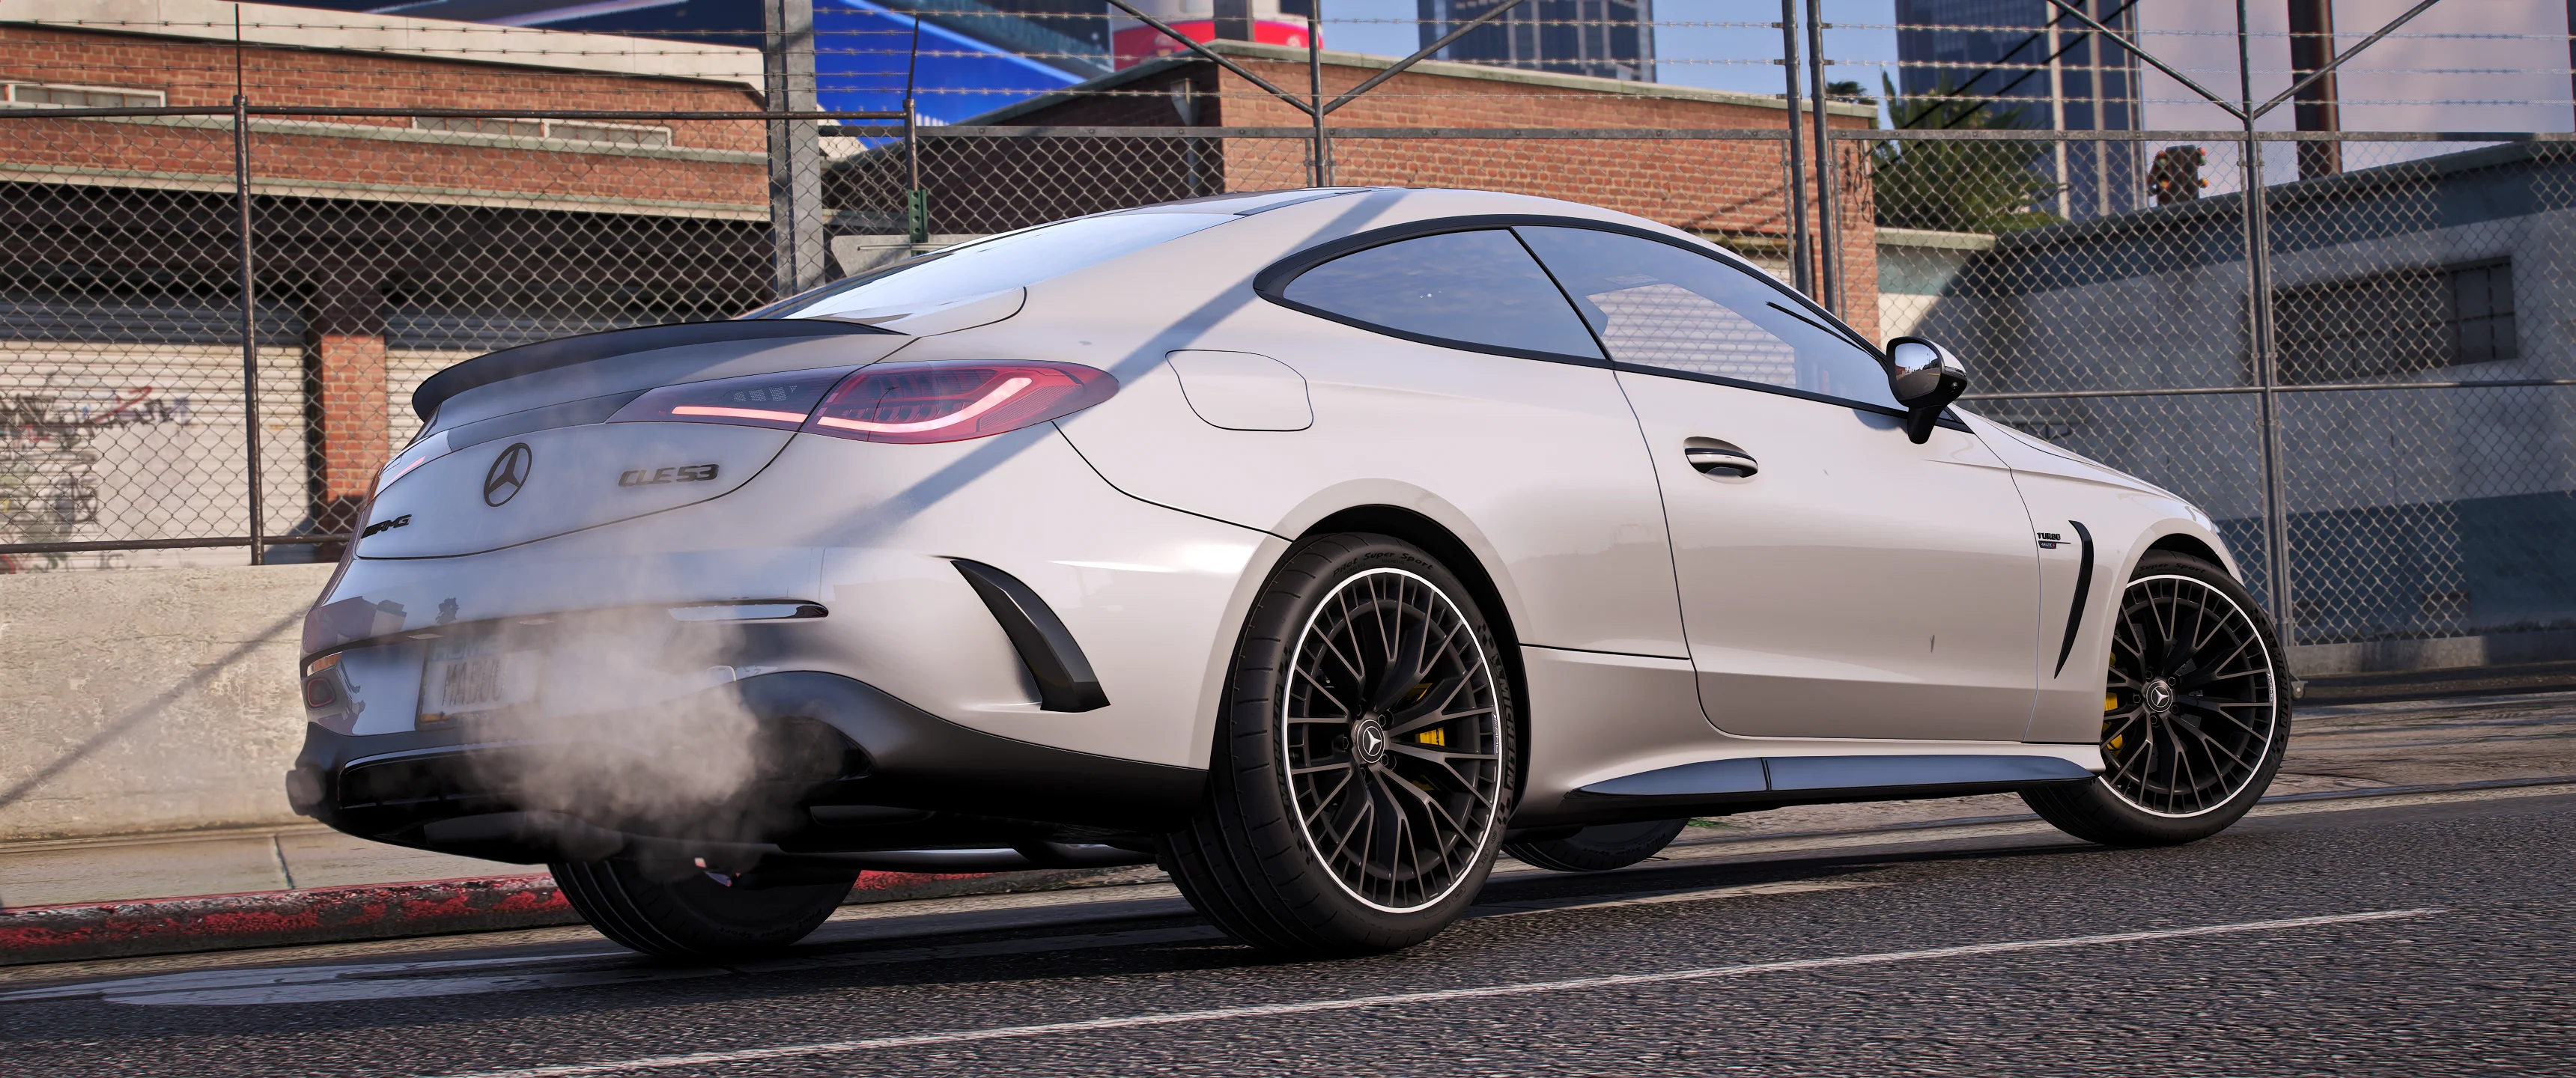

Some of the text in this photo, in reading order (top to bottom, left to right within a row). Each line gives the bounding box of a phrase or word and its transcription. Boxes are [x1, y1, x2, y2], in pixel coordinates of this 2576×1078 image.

[619, 464, 720, 487] CLE 53
[2037, 532, 2061, 540] TURBO
[1333, 552, 1434, 578] Pilot Super Sport
[2139, 563, 2206, 573] Super Sport
[2272, 648, 2288, 728] MICHELIN
[1274, 686, 1289, 806] MICHELIN
[1498, 677, 1516, 790] MICHELIN
